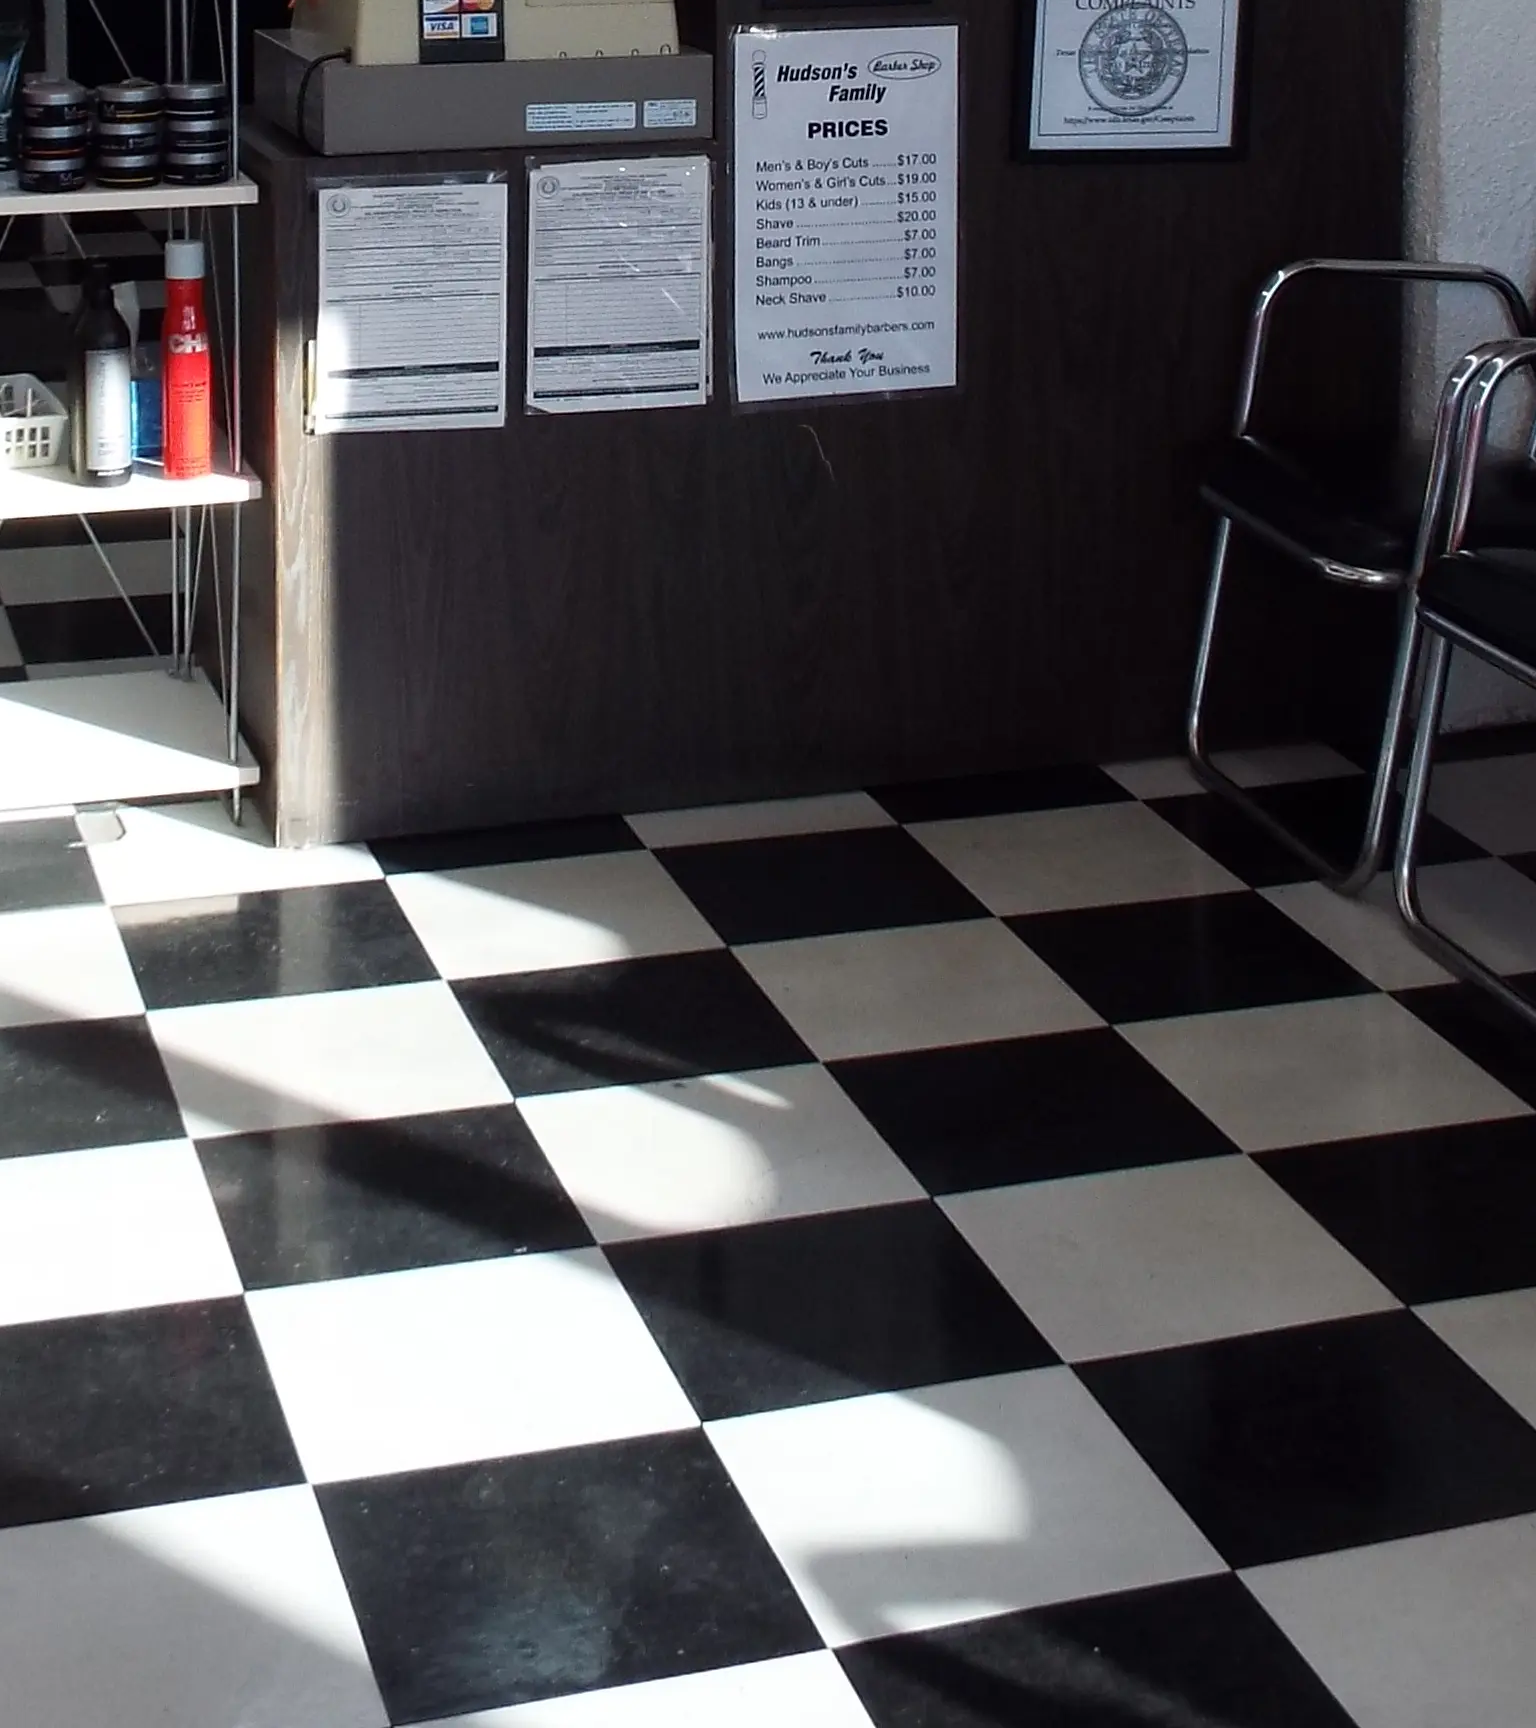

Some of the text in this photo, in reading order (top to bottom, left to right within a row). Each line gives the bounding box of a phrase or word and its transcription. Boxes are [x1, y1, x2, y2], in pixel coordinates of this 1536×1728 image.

[429, 21, 455, 32] VISA
[777, 62, 858, 83] Hudson's
[828, 83, 887, 104] Family
[807, 119, 889, 139] PRICES
[756, 153, 937, 173] Men's & Boy's Cuts $17.00
[756, 172, 937, 192] Women's & Girl's Cuts $19.00
[756, 191, 937, 211] Kids (13 & under) $15.00
[756, 210, 937, 230] Shave $20.00
[756, 228, 937, 249] Beard Trim $7.00
[756, 247, 937, 270] Bangs $7.00
[756, 266, 936, 288] Shampoo $7.00
[755, 285, 936, 307] Neck Shave $10.00
[809, 348, 885, 365] Thank You
[763, 363, 931, 385] We Appreciate Your Business
